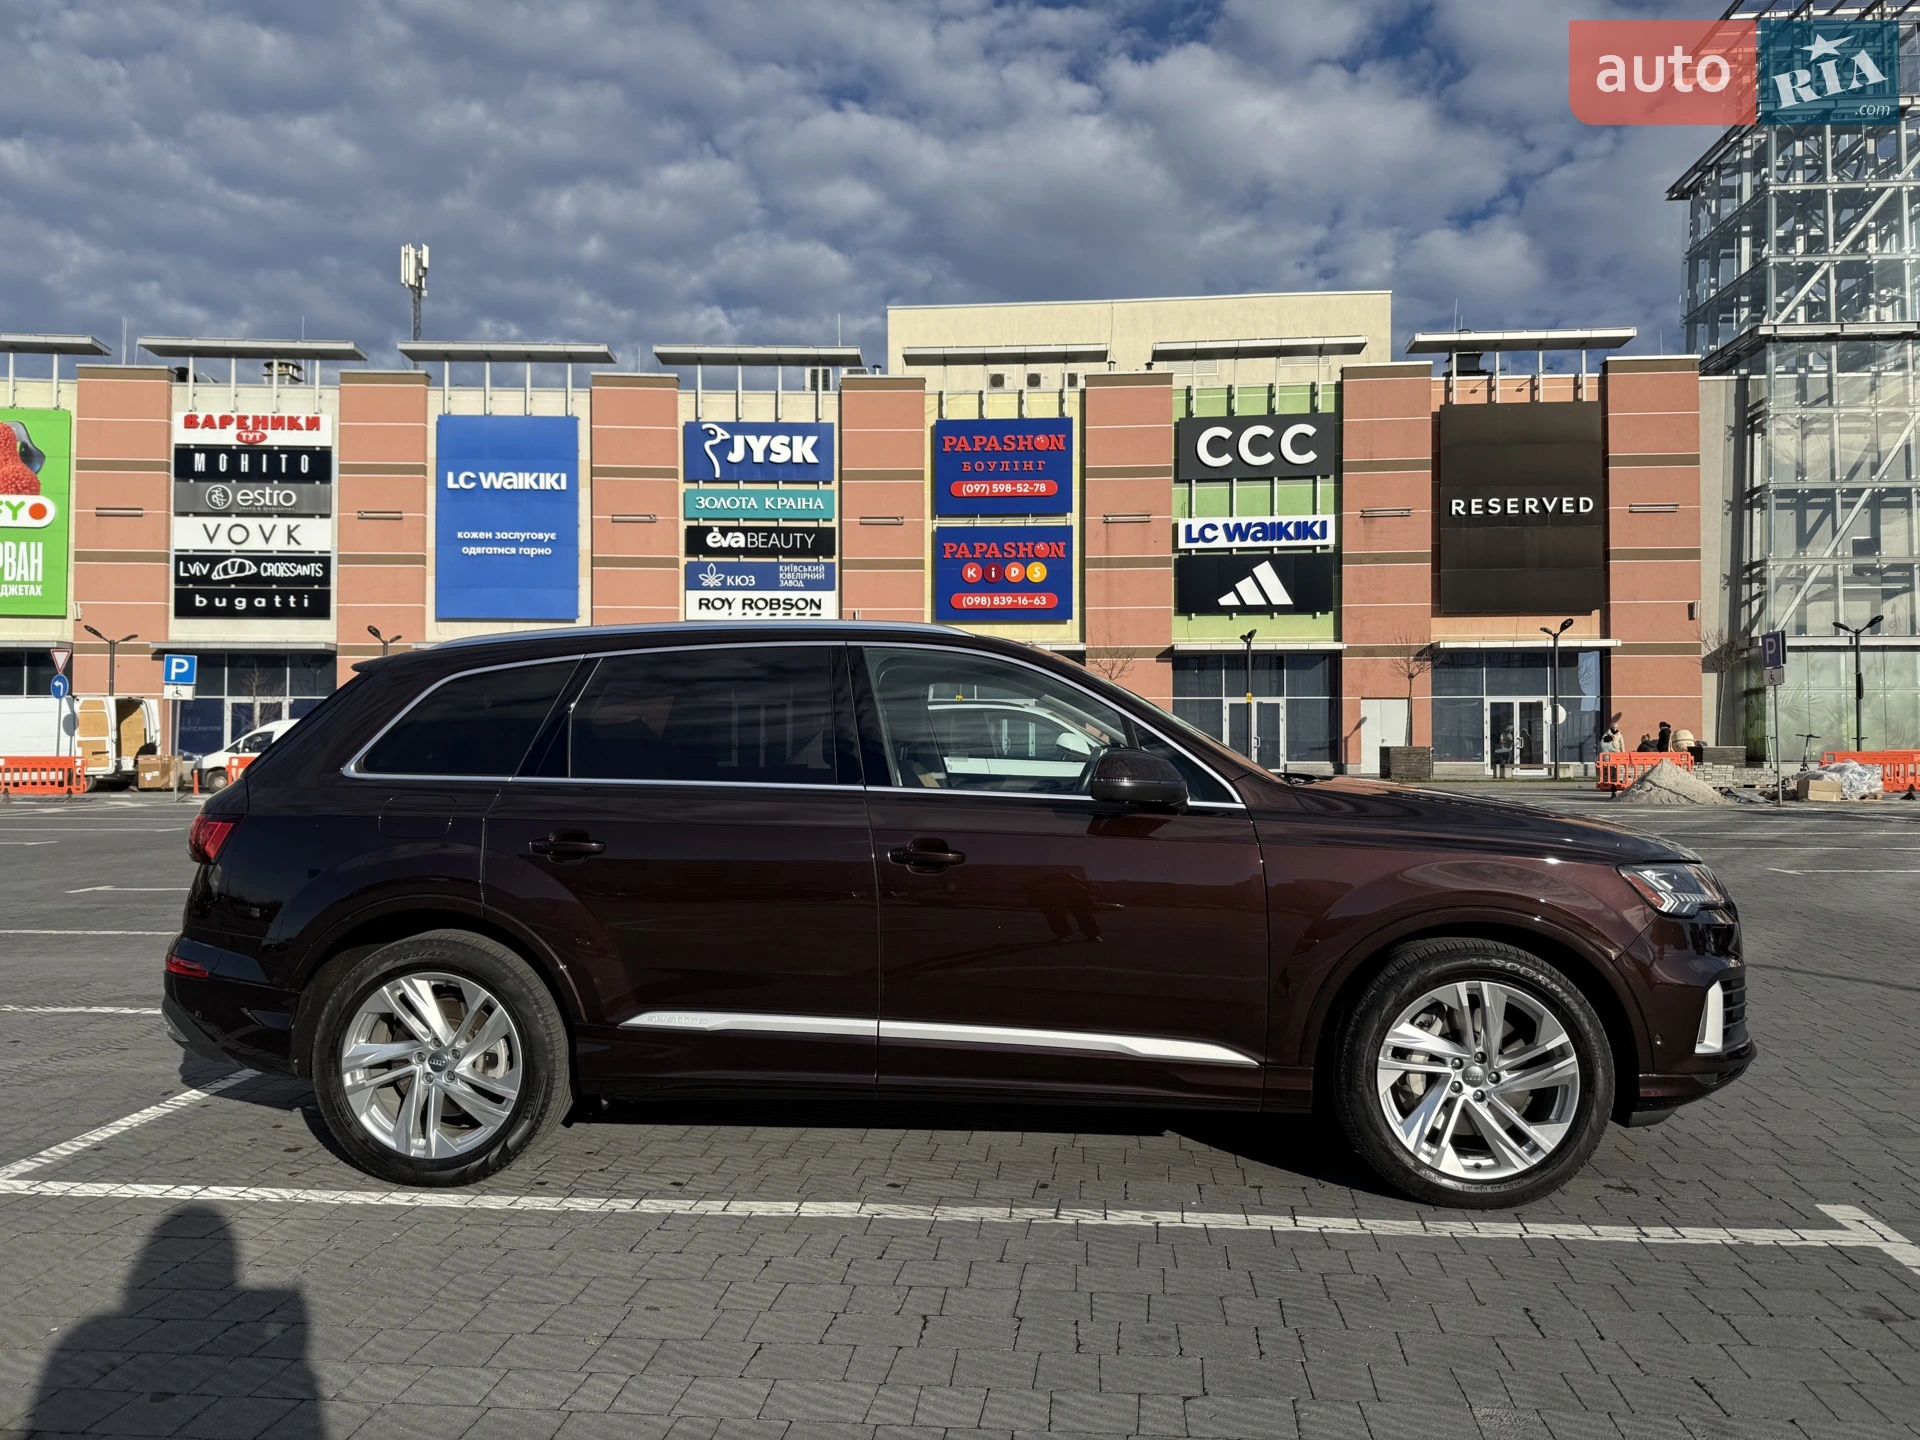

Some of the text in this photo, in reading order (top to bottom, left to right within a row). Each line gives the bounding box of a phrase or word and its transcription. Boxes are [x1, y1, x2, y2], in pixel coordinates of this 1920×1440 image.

[184, 414, 320, 431] ВАРЕНИКИ
[240, 432, 262, 441] ТУТ
[942, 434, 1066, 452] PAPASHON
[727, 434, 819, 464] JYSK
[1196, 423, 1318, 467] CCC
[194, 452, 310, 474] MOHITO
[962, 460, 1046, 472] БОУЛІНГ
[447, 471, 477, 489] LC
[236, 486, 297, 507] estro
[962, 483, 1046, 495] (097) 598-52-78
[0, 500, 26, 521] Y
[695, 496, 758, 510] ЗОЛОТА
[1450, 496, 1594, 516] RESERVED
[202, 523, 302, 546] VOVK
[457, 531, 557, 543] кожен заслуговує
[747, 532, 816, 549] BEAUTY
[1185, 522, 1219, 543] LC
[462, 546, 552, 558] одягатися гарно
[943, 542, 1066, 558] PAPASHON
[779, 564, 825, 573] КИЇВСЬКИЙ
[779, 572, 825, 580] ЮВЕЛІРНИЙ
[726, 575, 756, 587] КЮЗ
[779, 580, 805, 588] ЗАВОД
[195, 594, 309, 610] bugatti
[698, 597, 822, 611] ROY ROBSON
[962, 595, 1047, 608] (098) 839-16-63
[1765, 637, 1777, 664] P
[171, 658, 189, 680] P
